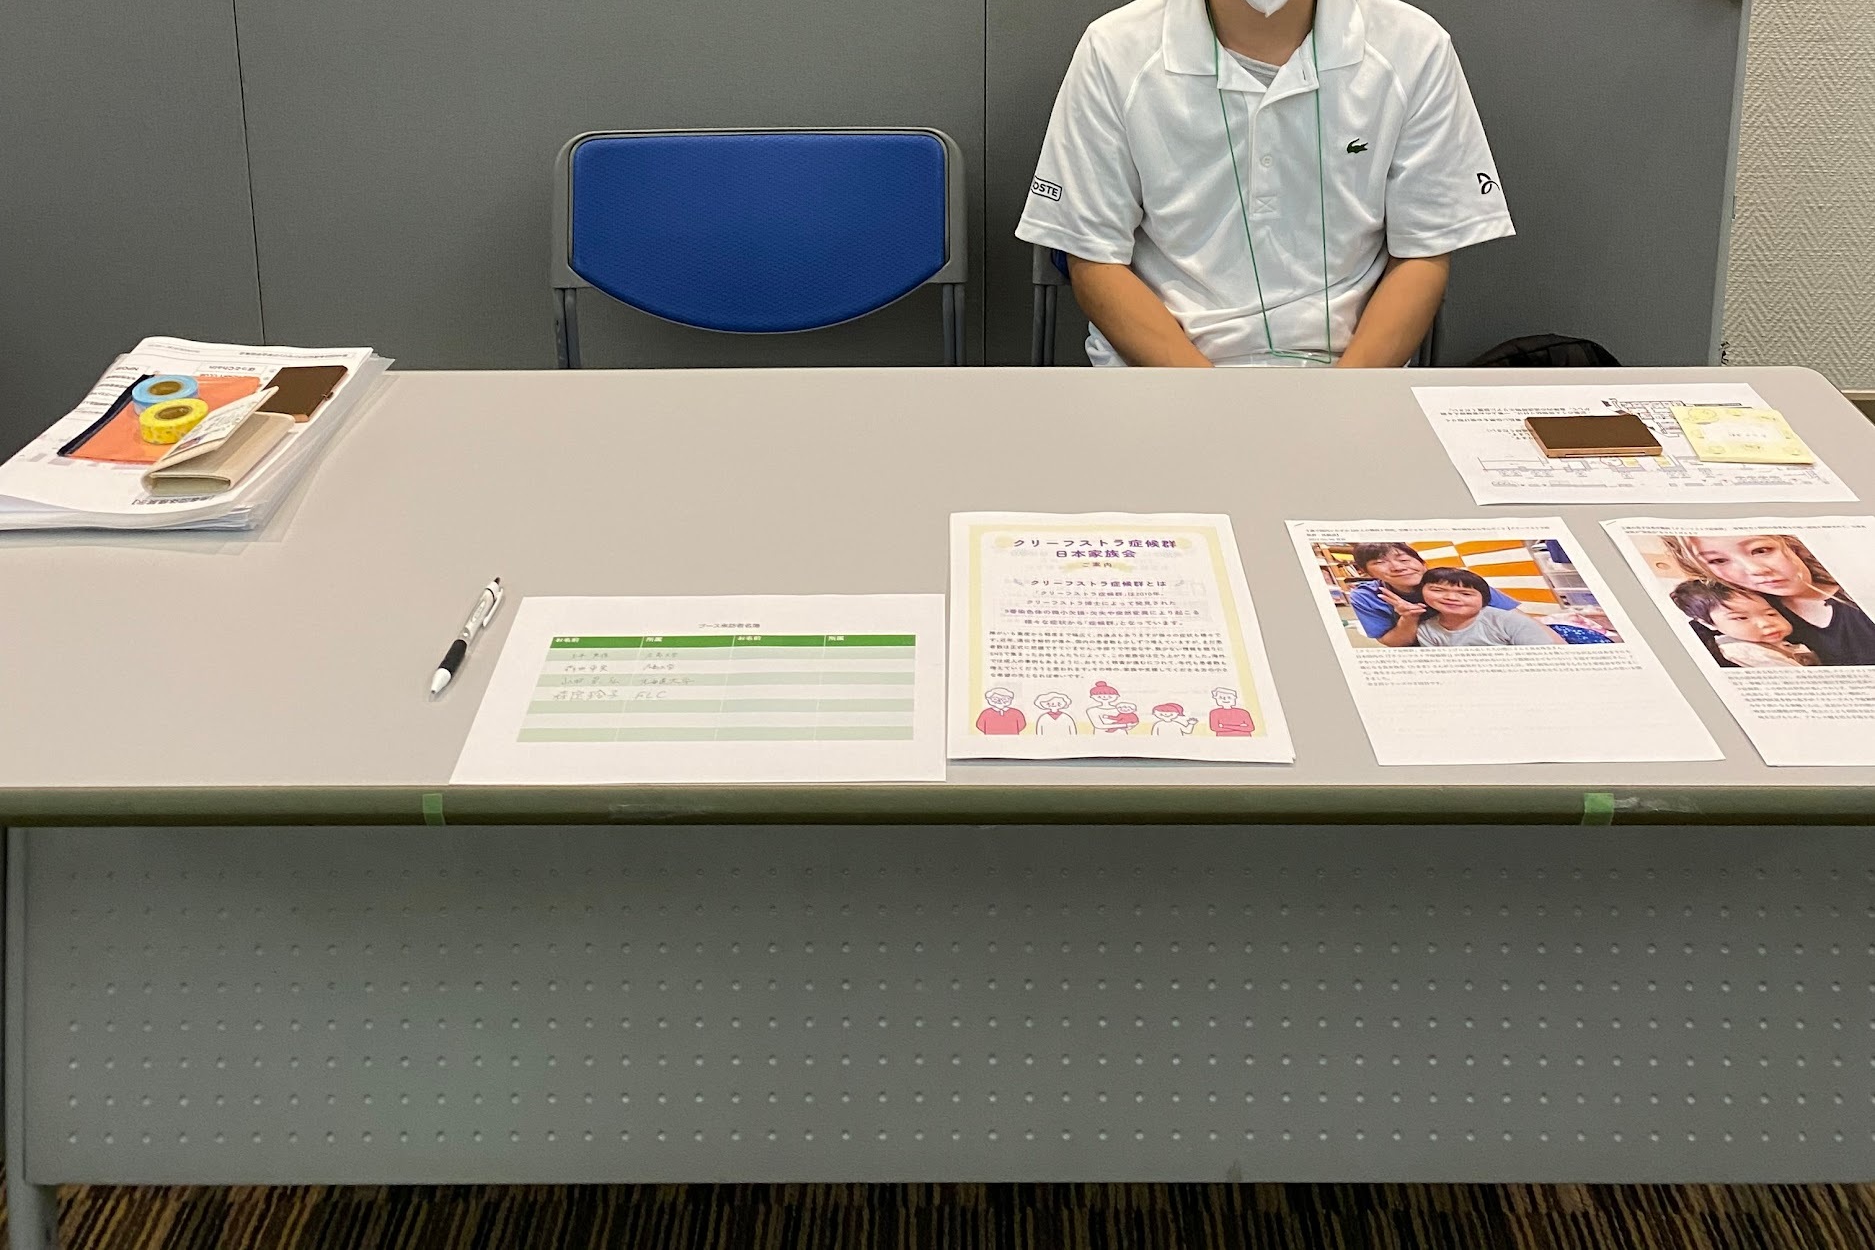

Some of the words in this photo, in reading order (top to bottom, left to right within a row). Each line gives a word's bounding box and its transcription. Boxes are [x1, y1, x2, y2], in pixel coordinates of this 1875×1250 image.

[1013, 538, 1177, 549] クリーフストラ症候群
[1055, 549, 1137, 559] 日本家族会
[1030, 579, 1167, 588] クリーフストラ症候群とは
